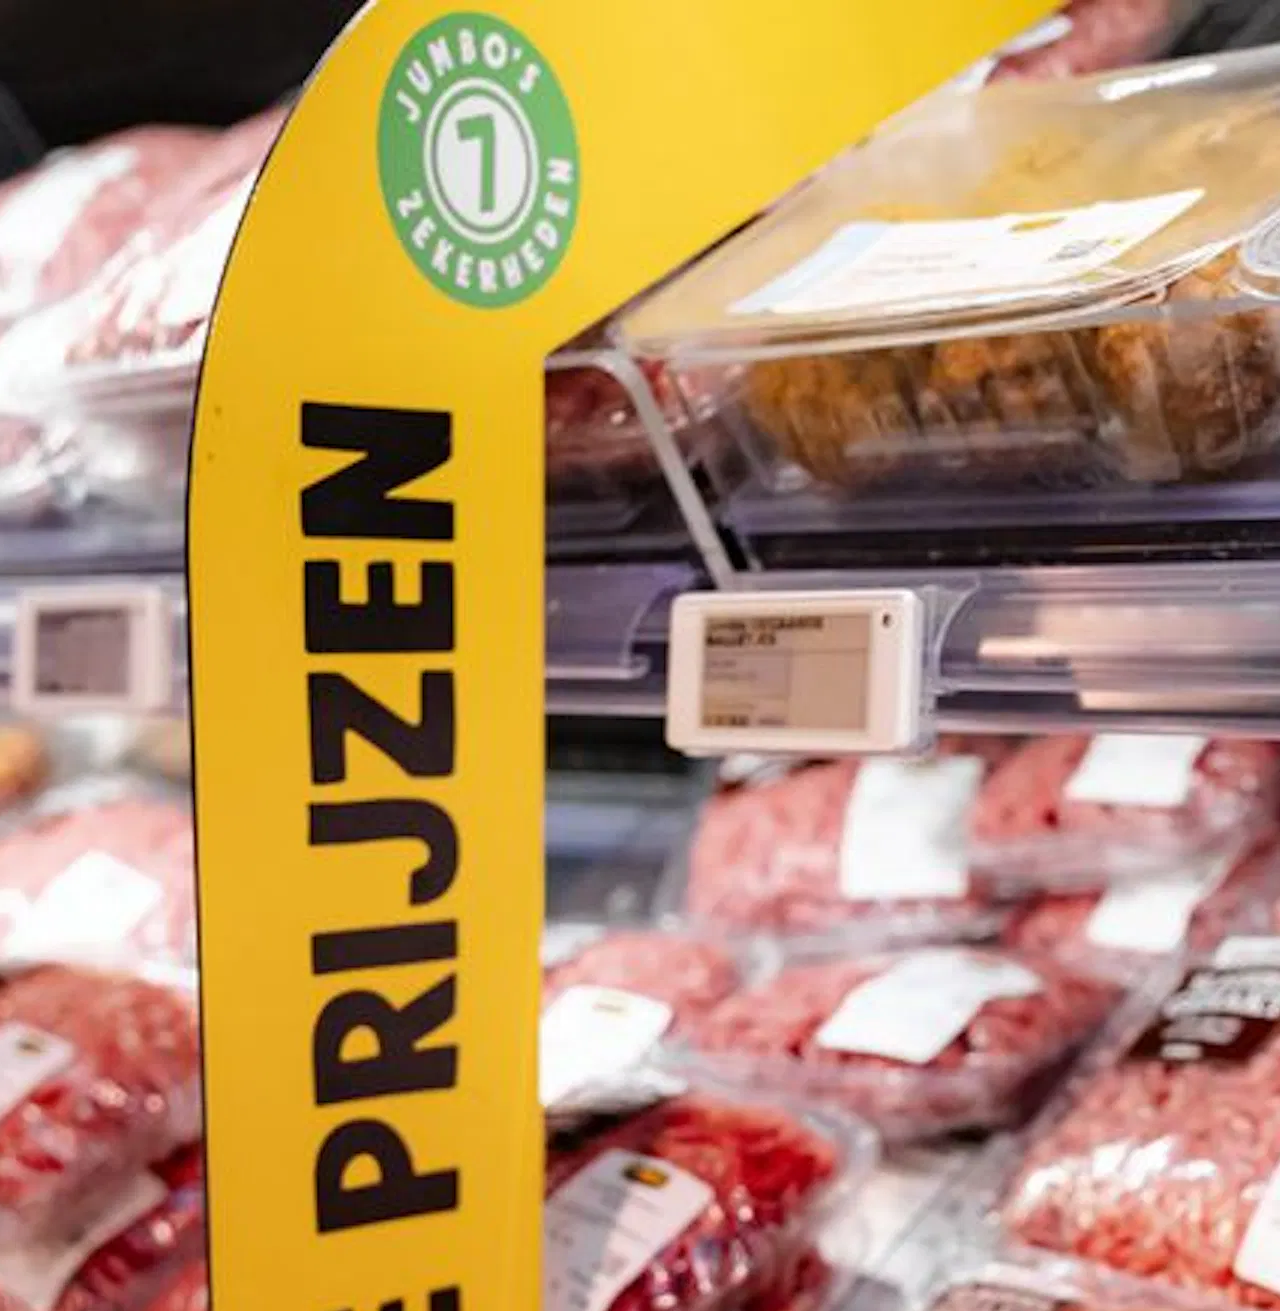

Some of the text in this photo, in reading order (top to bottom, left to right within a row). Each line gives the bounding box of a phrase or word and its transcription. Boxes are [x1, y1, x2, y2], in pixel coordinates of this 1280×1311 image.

[395, 27, 542, 124] JUMBO'S
[456, 112, 497, 215] 7
[300, 401, 458, 1234] PRIJZEN
